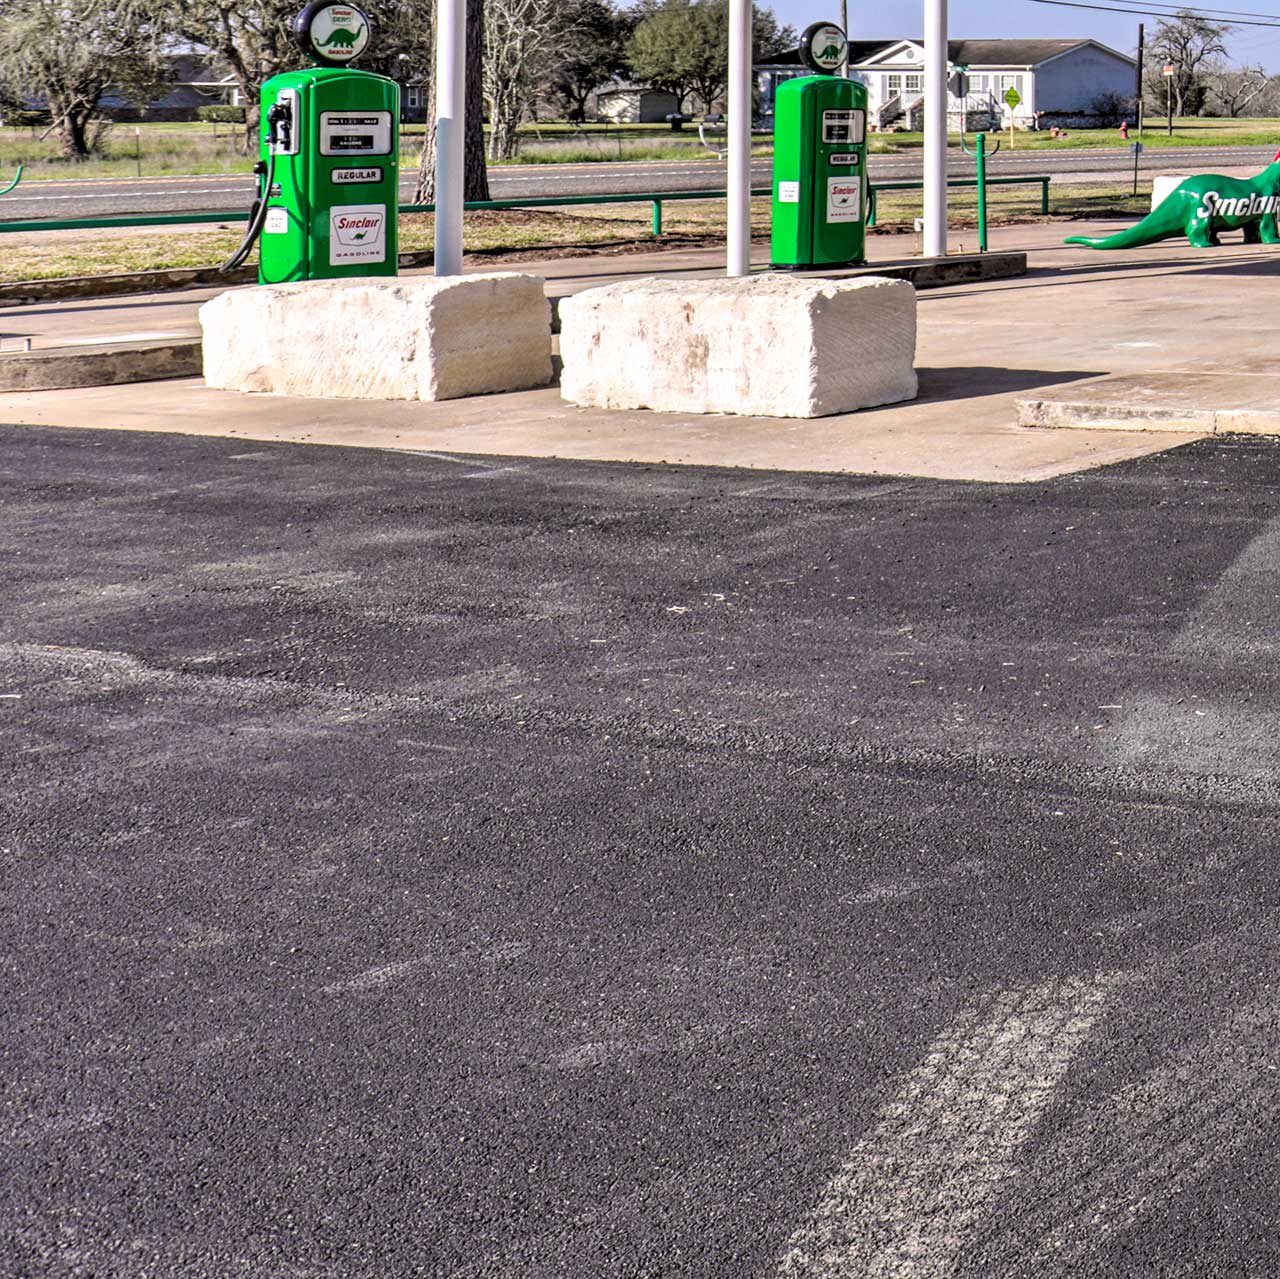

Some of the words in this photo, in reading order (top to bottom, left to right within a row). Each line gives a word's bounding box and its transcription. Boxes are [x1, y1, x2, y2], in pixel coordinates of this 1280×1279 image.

[337, 171, 377, 180] REGULAR
[1197, 191, 1280, 218] Sinclair
[337, 216, 380, 230] Sinclair
[335, 250, 380, 258] GASOLINE
